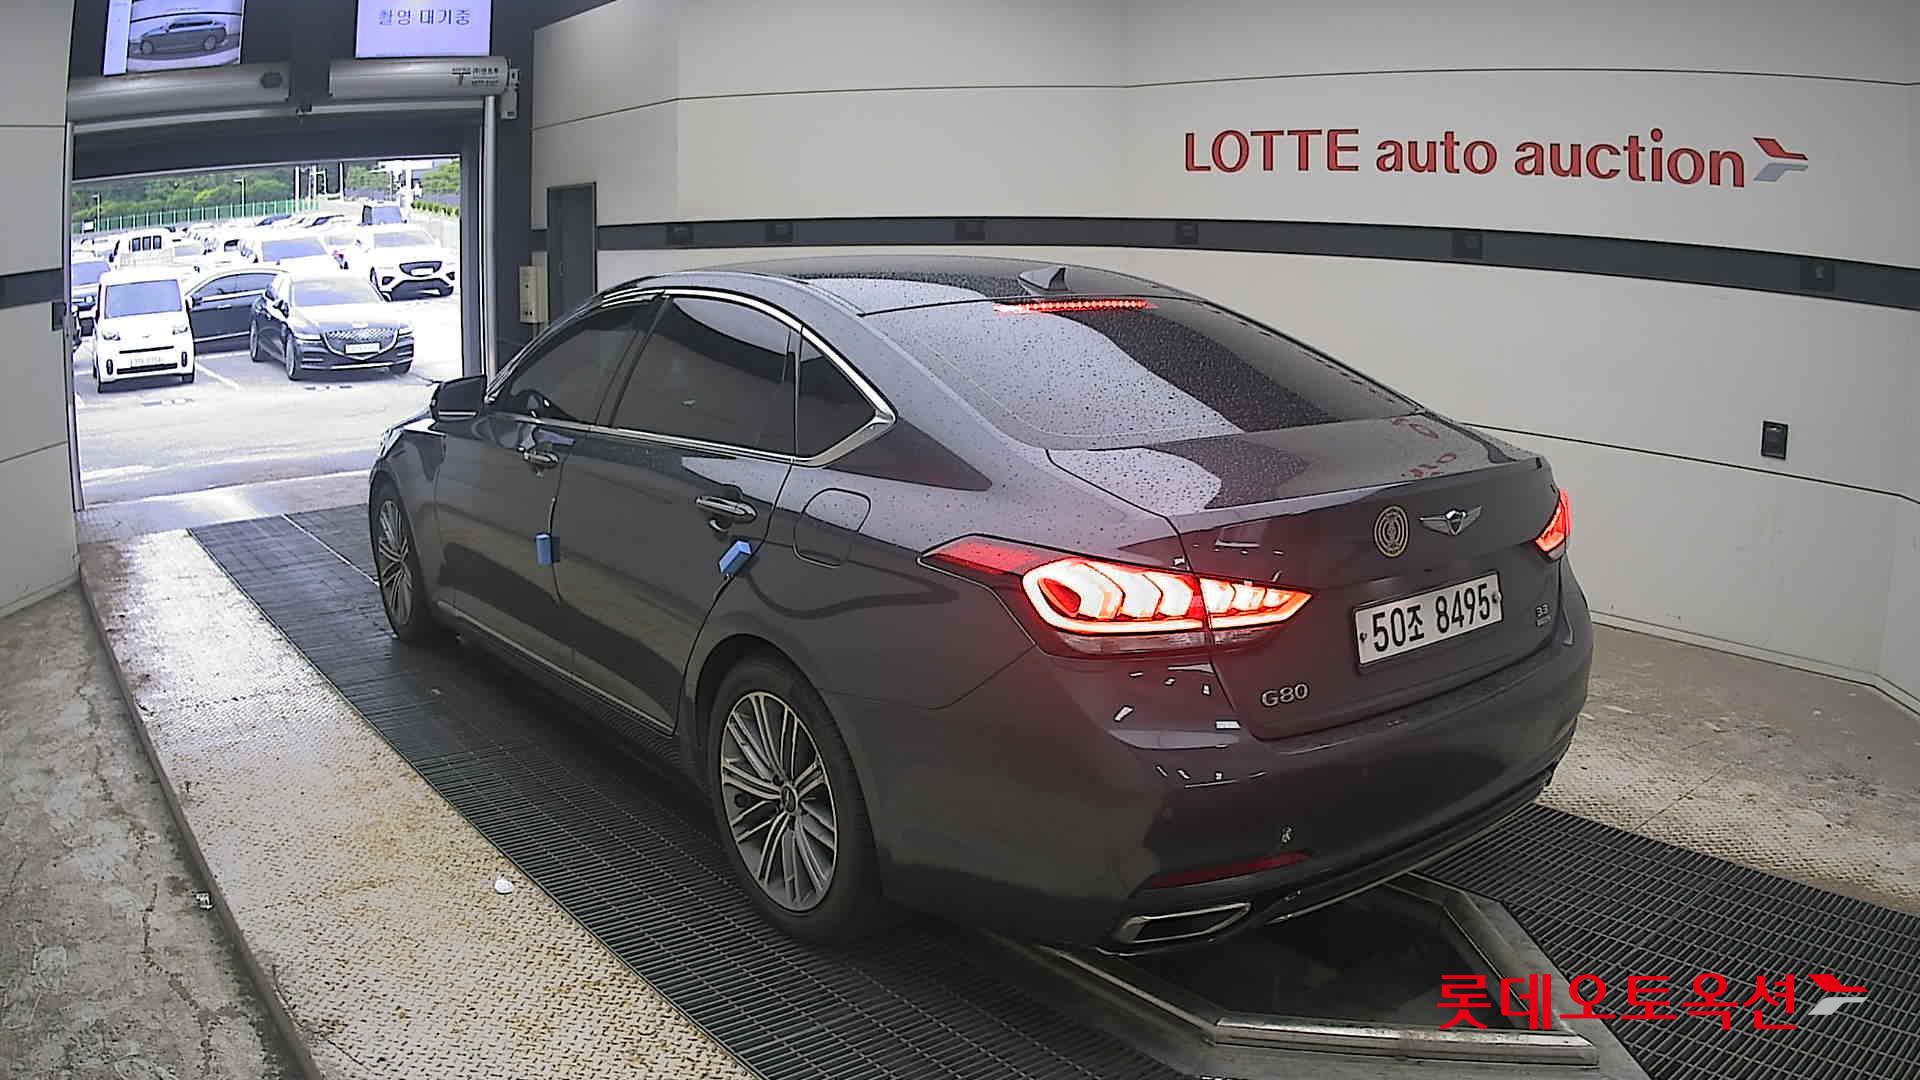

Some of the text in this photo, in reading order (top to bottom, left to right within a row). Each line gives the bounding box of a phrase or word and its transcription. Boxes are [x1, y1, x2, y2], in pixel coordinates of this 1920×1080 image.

[419, 9, 471, 26] 대기중
[1185, 128, 1745, 188] LOTTE auto auction
[1372, 583, 1490, 652] 50조 8495
[1261, 683, 1309, 707] G80
